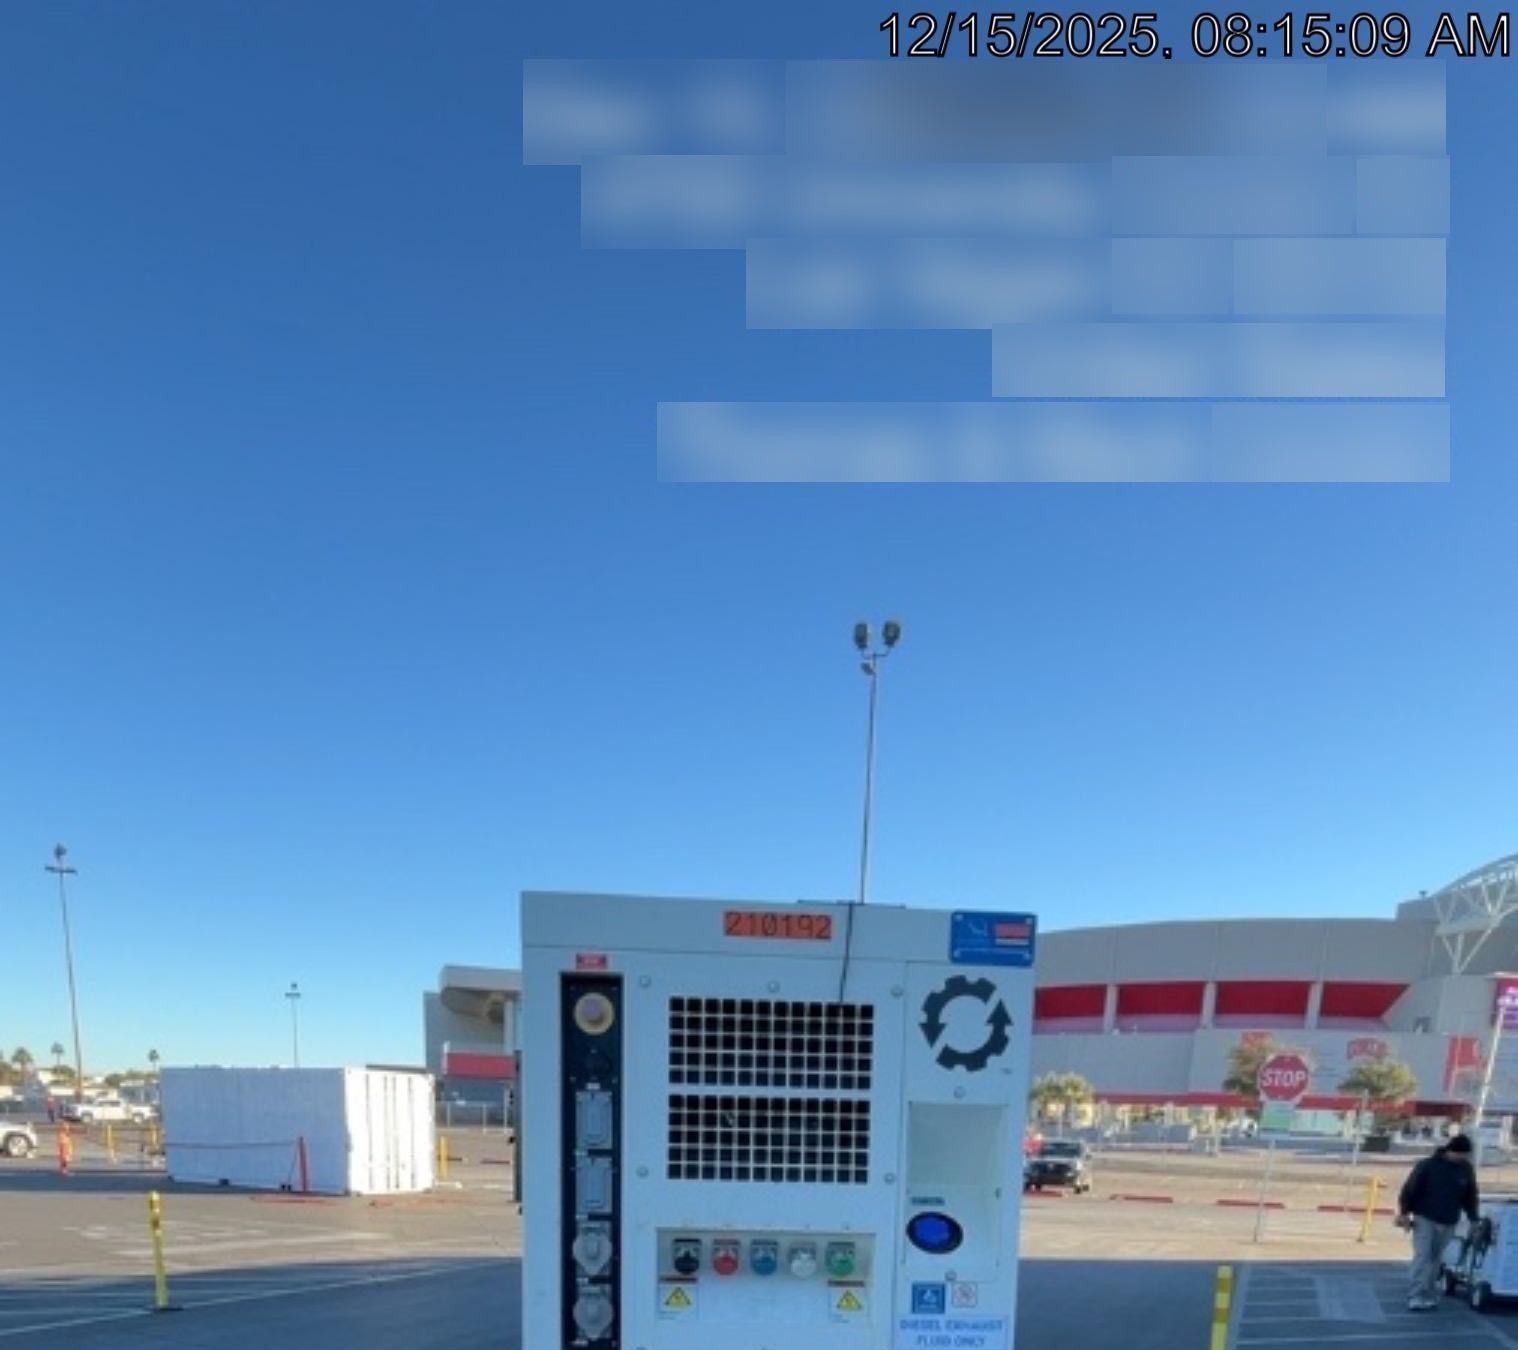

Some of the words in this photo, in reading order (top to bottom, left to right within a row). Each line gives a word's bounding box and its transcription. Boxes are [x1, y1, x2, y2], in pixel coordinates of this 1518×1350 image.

[724, 911, 832, 939] 210192
[1262, 1069, 1307, 1087] STOP
[900, 1319, 940, 1330] DIESEL
[944, 1319, 1003, 1330] EXHAUST
[917, 1334, 951, 1346] FLUID
[953, 1335, 986, 1347] ONLY
